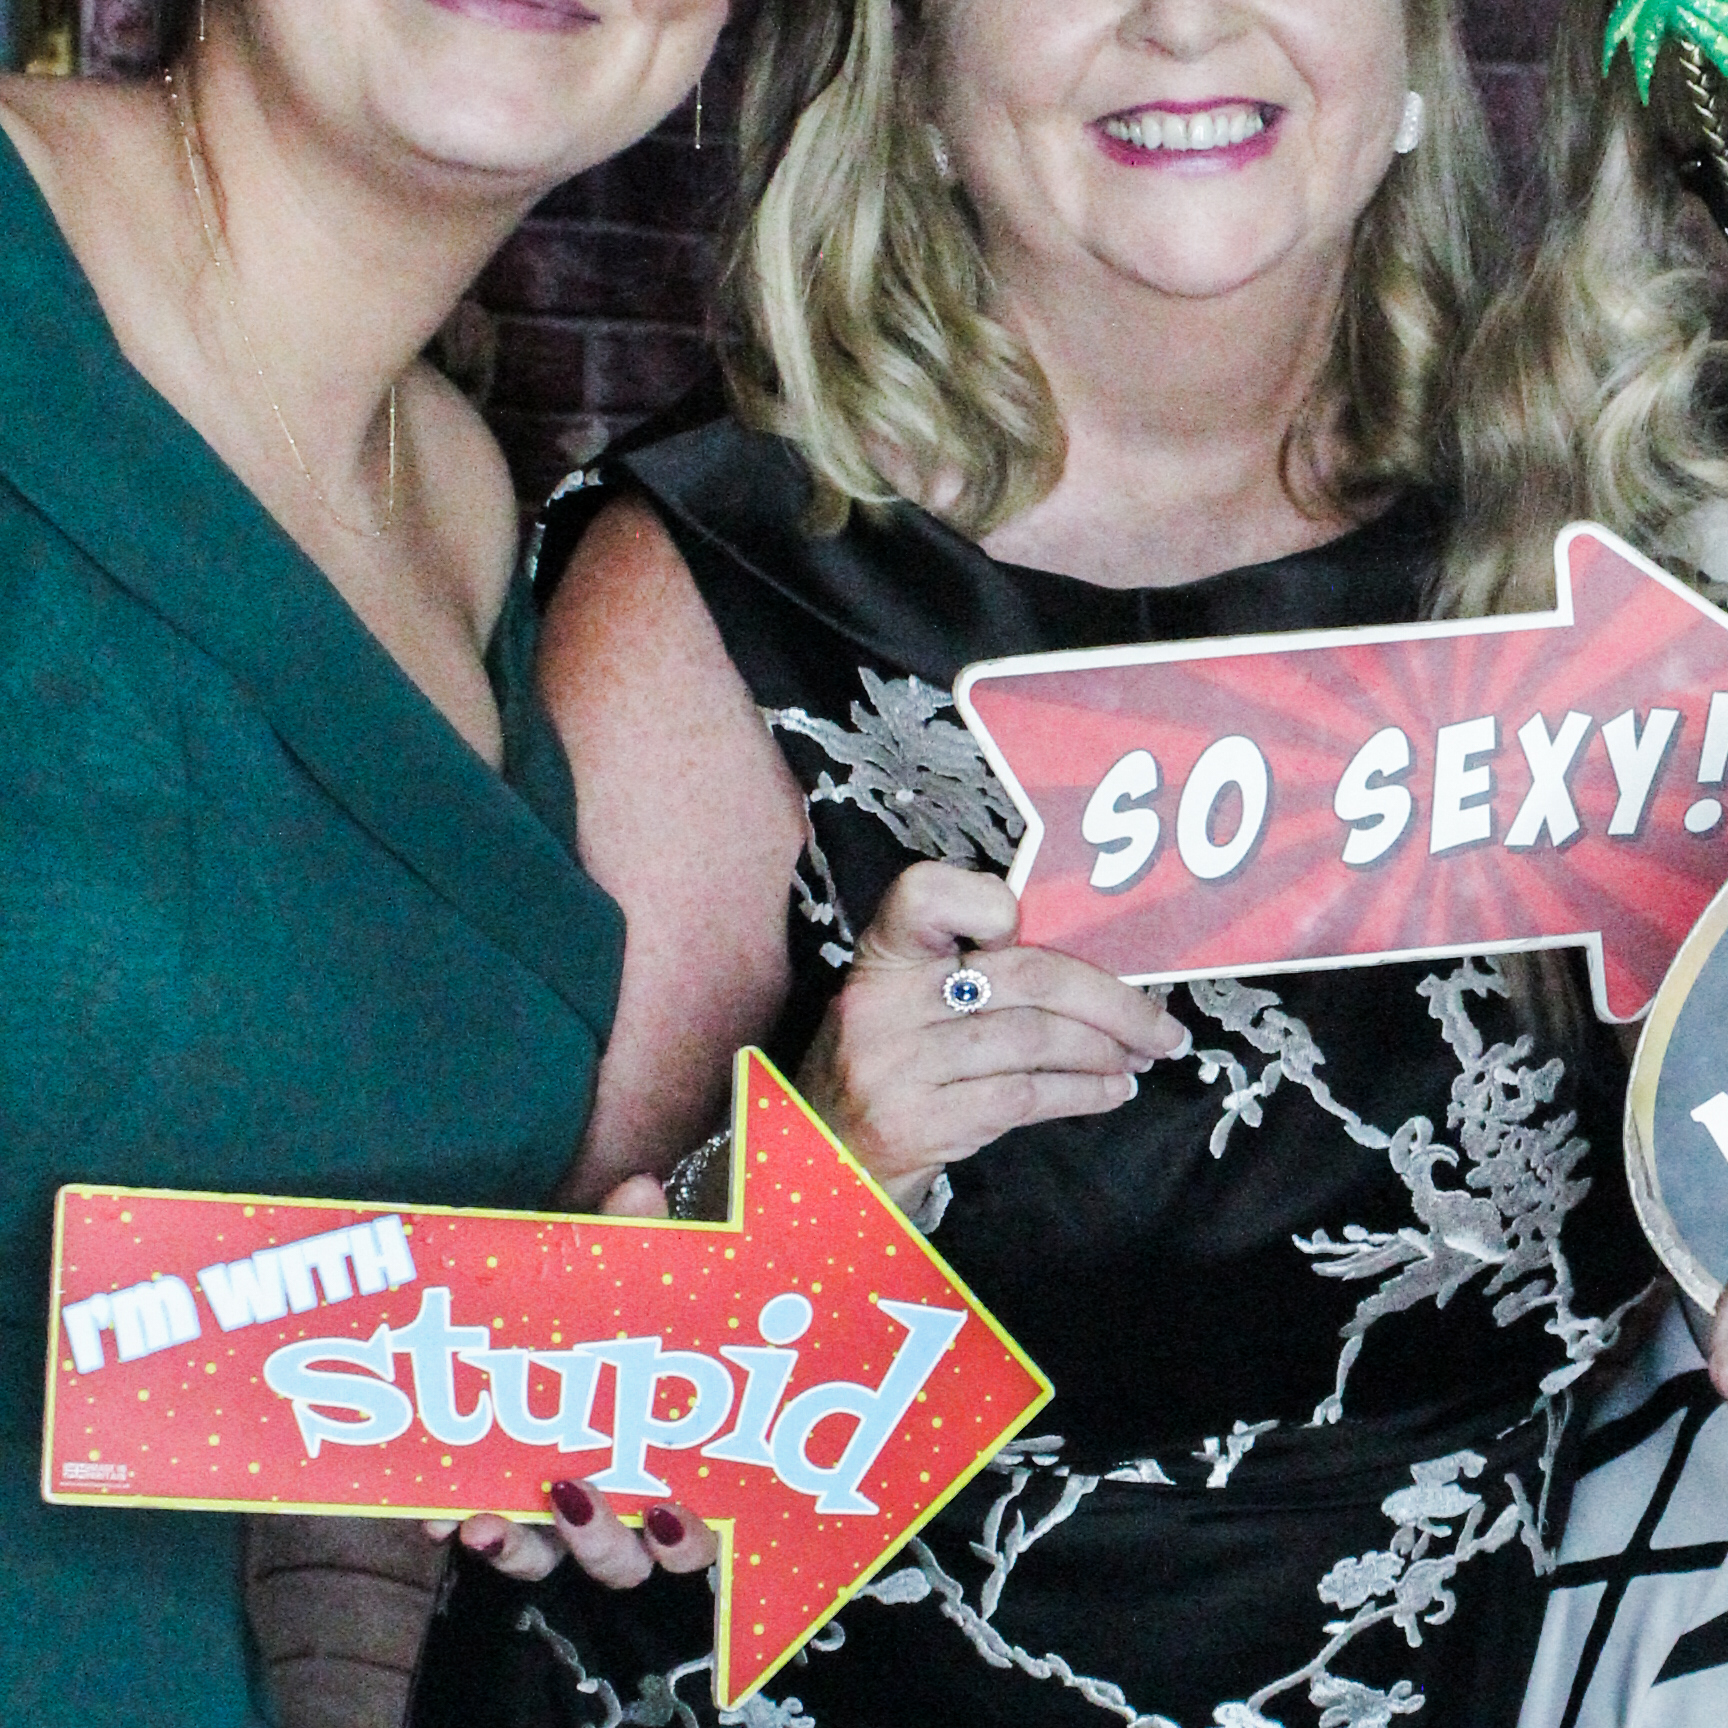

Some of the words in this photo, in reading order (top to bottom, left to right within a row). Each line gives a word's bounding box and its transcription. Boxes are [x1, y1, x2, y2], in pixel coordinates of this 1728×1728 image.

[1081, 734, 1270, 889] SO
[196, 1213, 418, 1333] WITH
[264, 1286, 967, 1515] stupid
